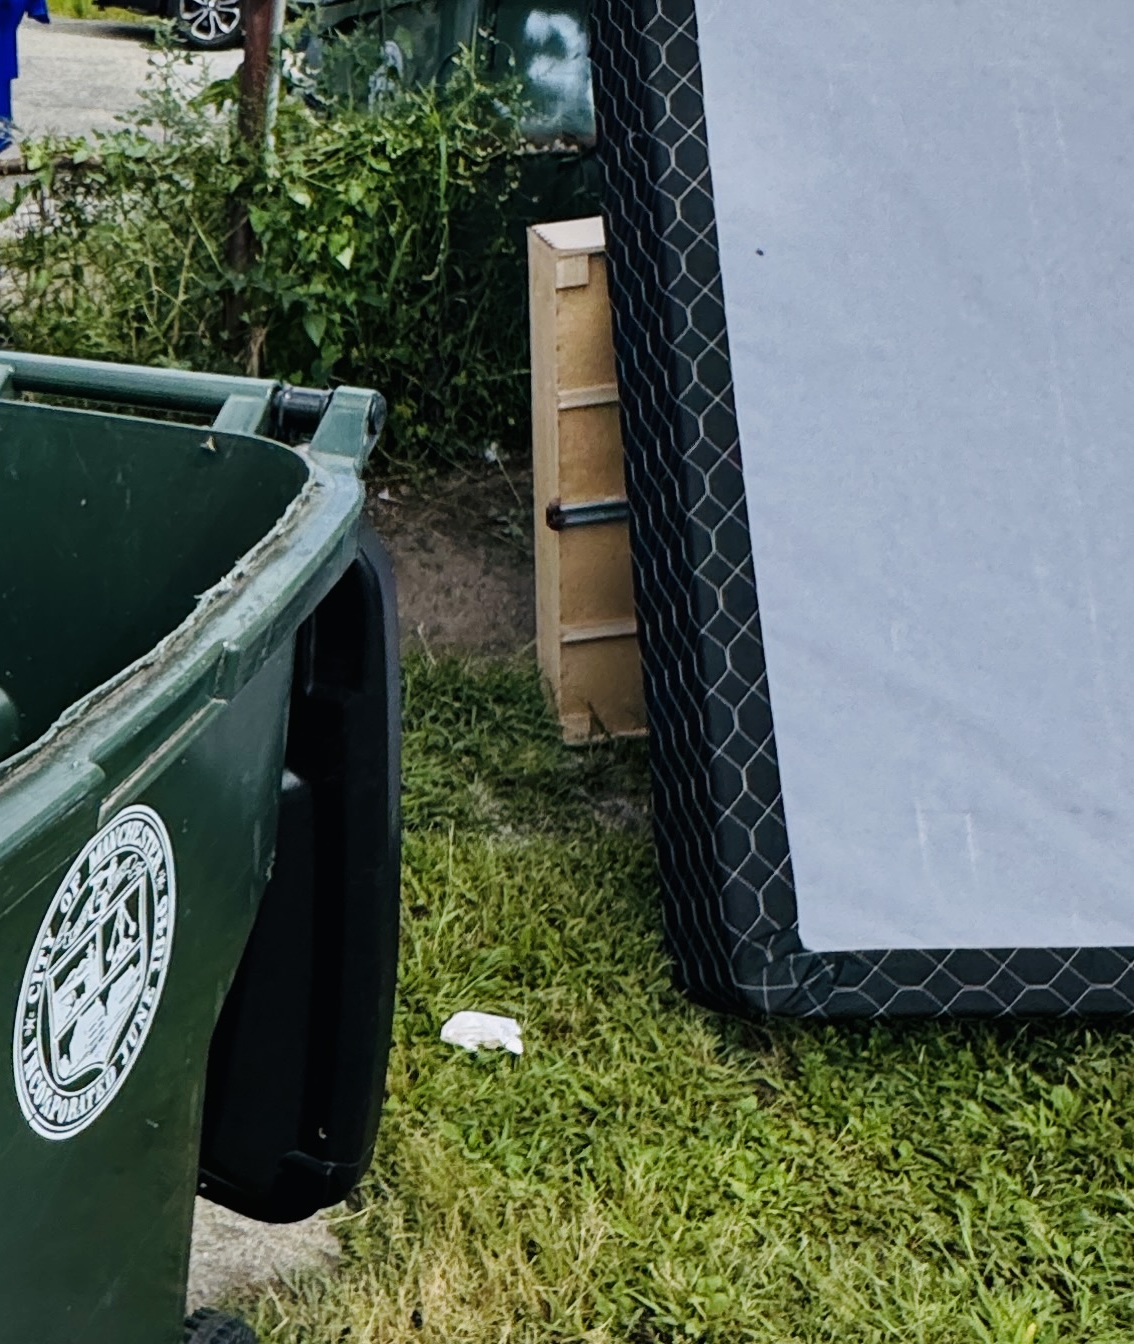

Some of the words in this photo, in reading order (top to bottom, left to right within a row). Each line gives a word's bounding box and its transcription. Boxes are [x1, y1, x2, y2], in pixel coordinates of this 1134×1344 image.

[26, 927, 55, 1004] CITY
[60, 871, 82, 914] OF
[89, 820, 163, 881] MANCHESTER
[22, 1037, 117, 1124] INCORPORATED
[121, 985, 156, 1065] JUNE
